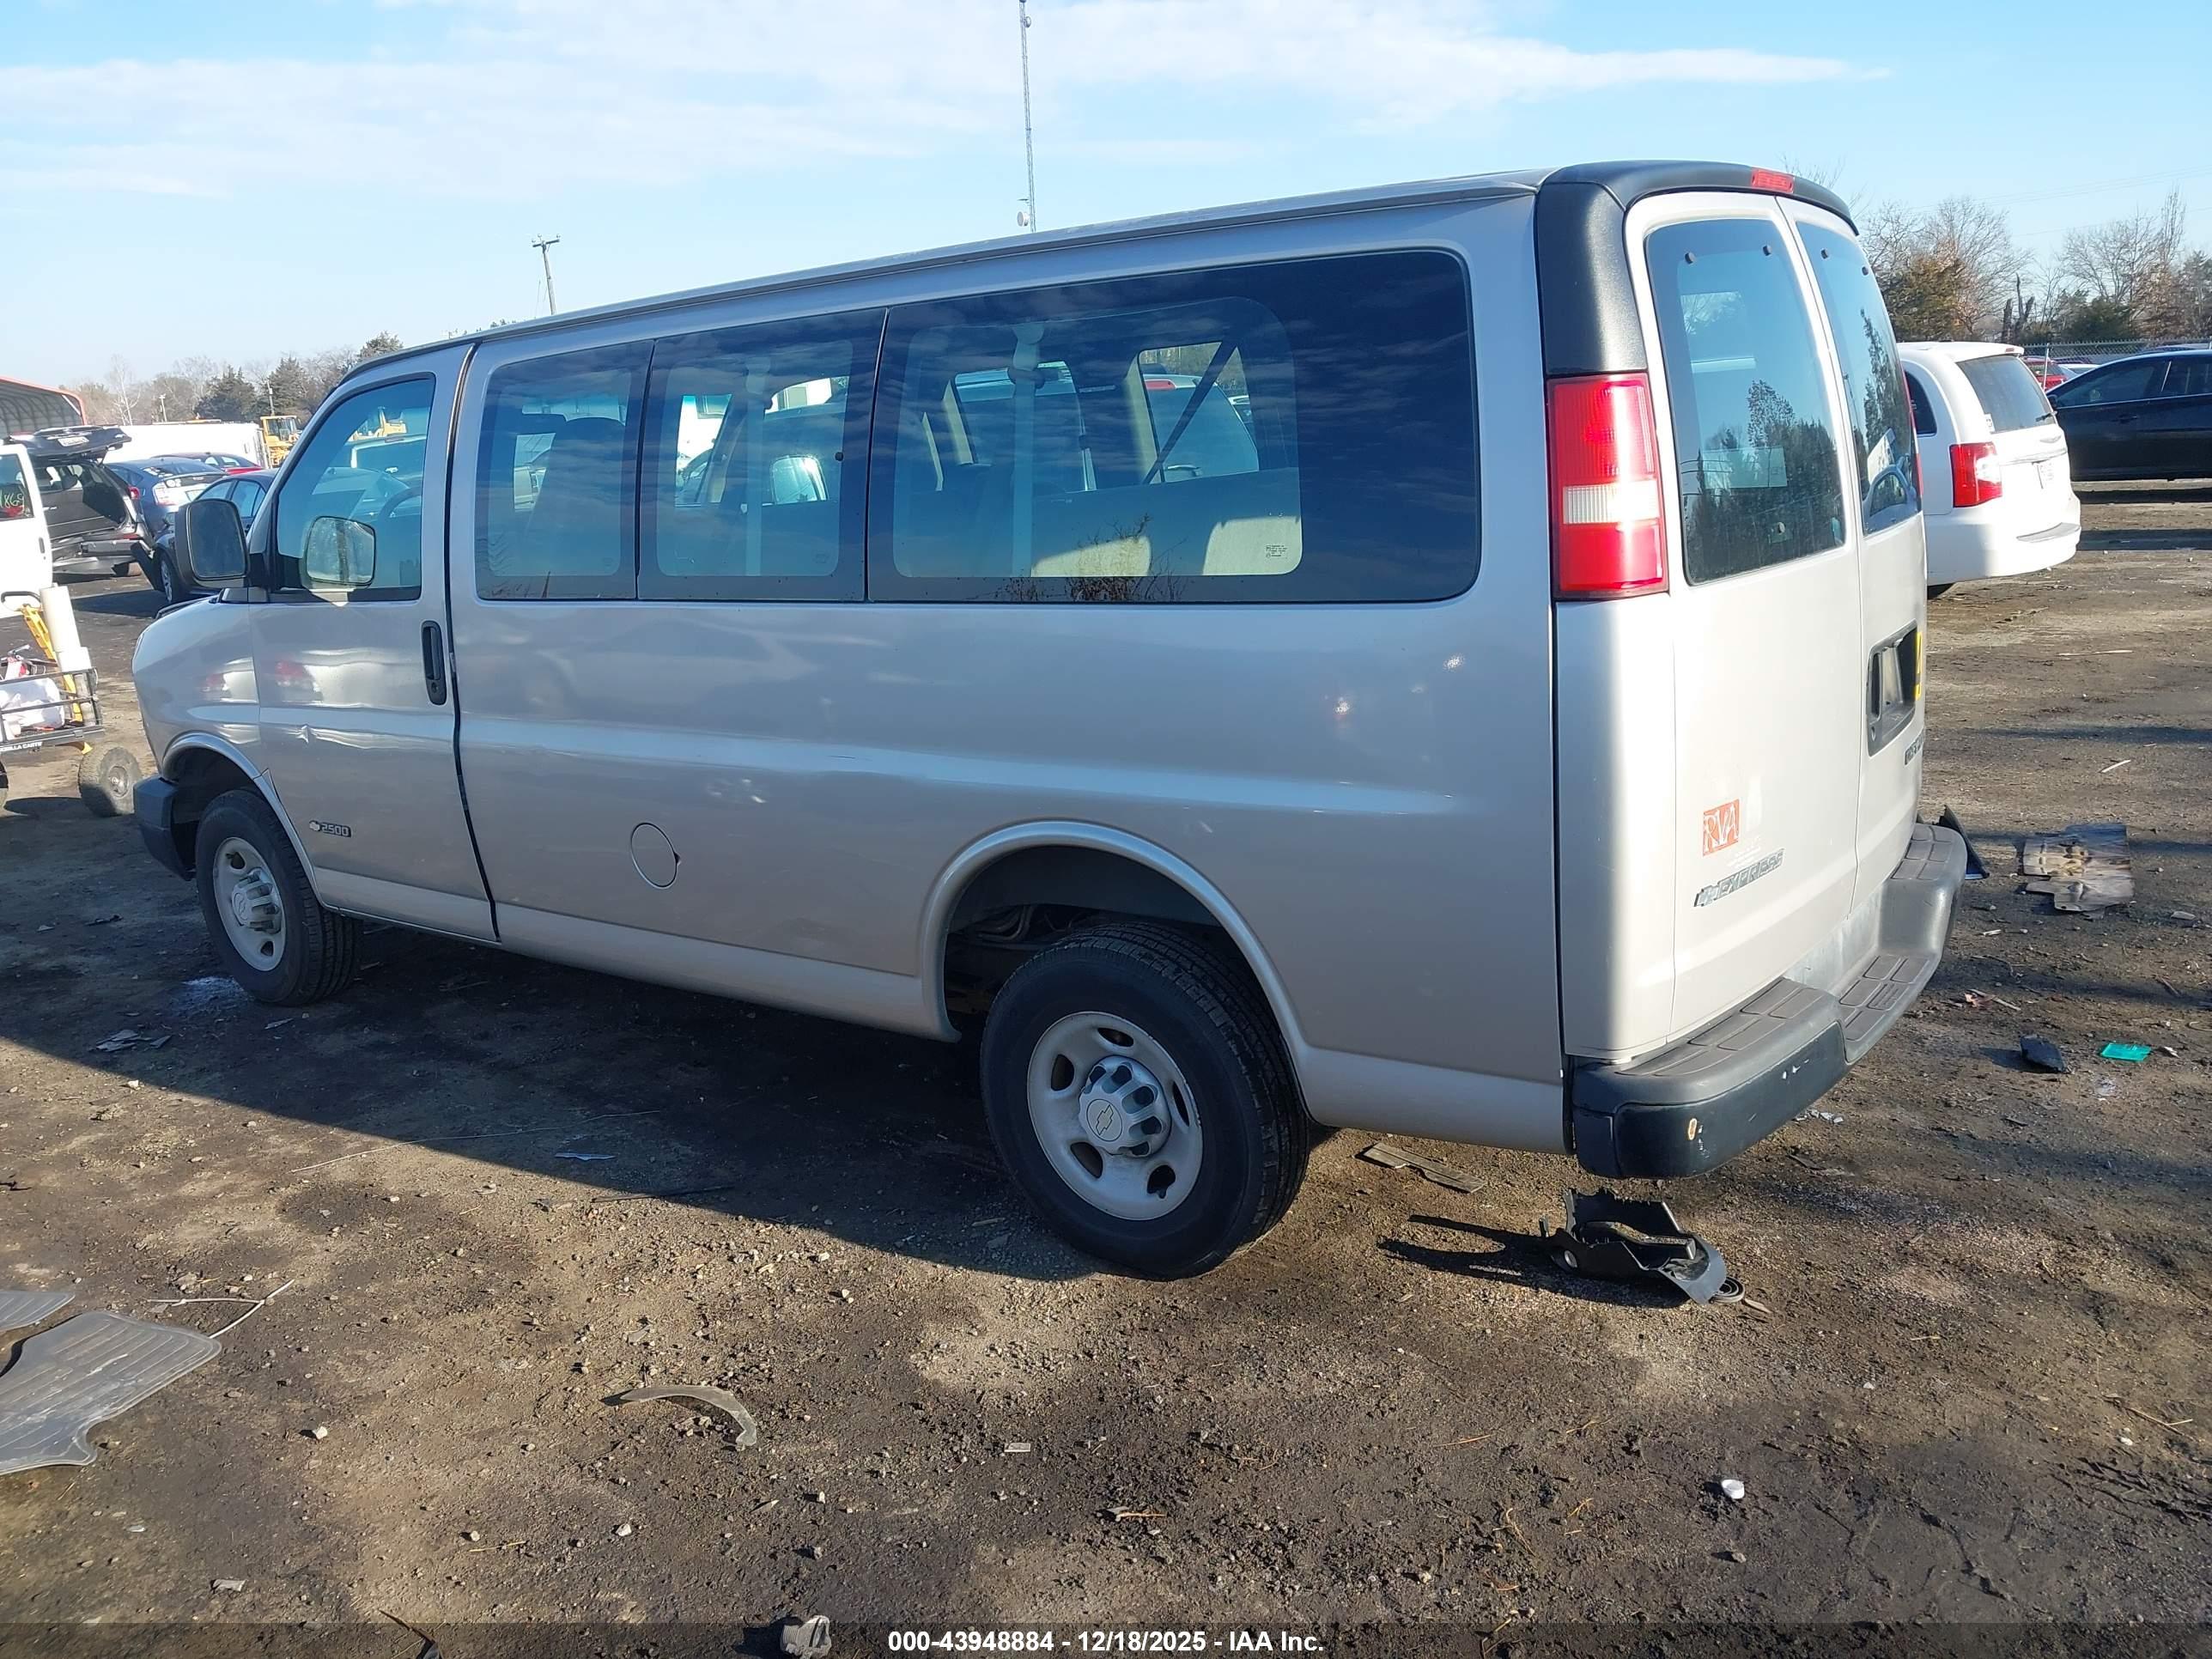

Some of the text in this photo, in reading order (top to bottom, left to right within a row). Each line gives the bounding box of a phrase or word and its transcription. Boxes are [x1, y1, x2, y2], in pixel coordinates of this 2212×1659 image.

[321, 823, 349, 837] 2500
[1704, 803, 1738, 854] RVA
[1717, 848, 1784, 899] EXPRESS
